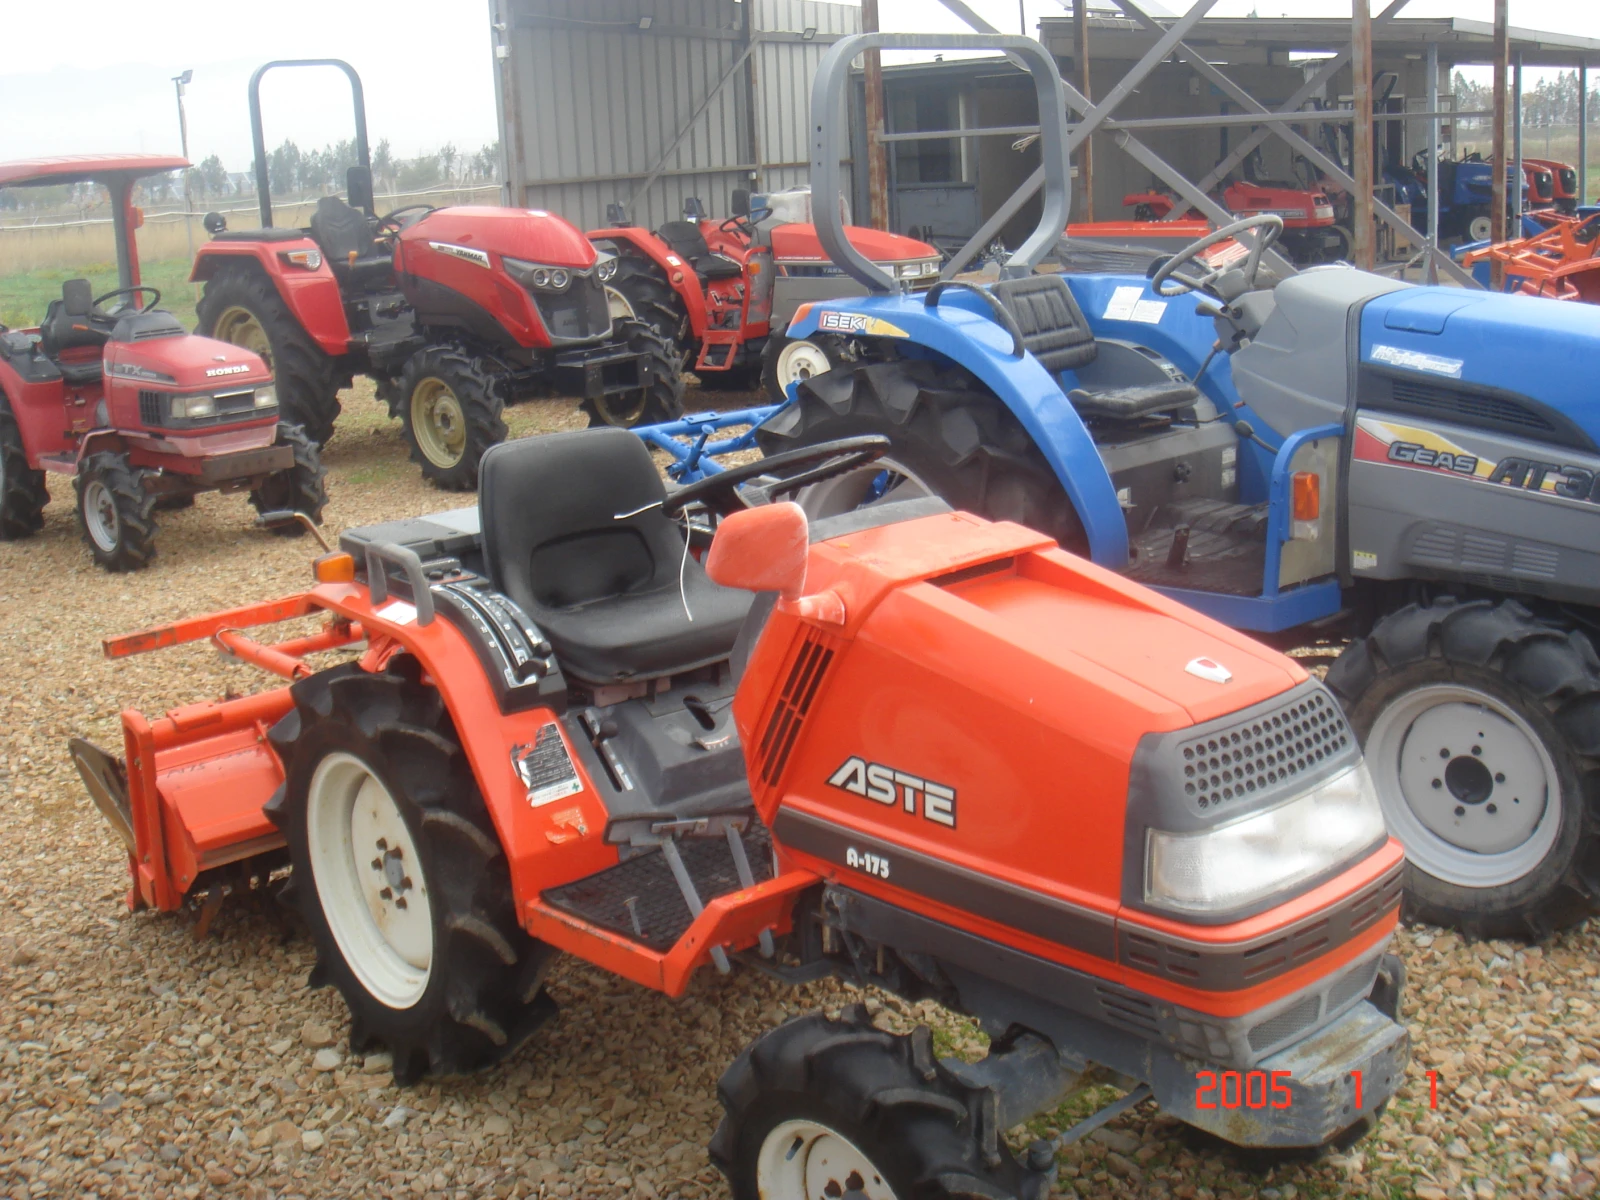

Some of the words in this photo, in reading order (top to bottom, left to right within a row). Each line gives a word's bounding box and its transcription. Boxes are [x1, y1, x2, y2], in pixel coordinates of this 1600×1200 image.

[822, 314, 868, 331] ISEKI
[206, 364, 250, 377] HONDA
[1387, 440, 1479, 475] GEAS
[826, 756, 956, 829] ASTE
[846, 846, 890, 879] A-175
